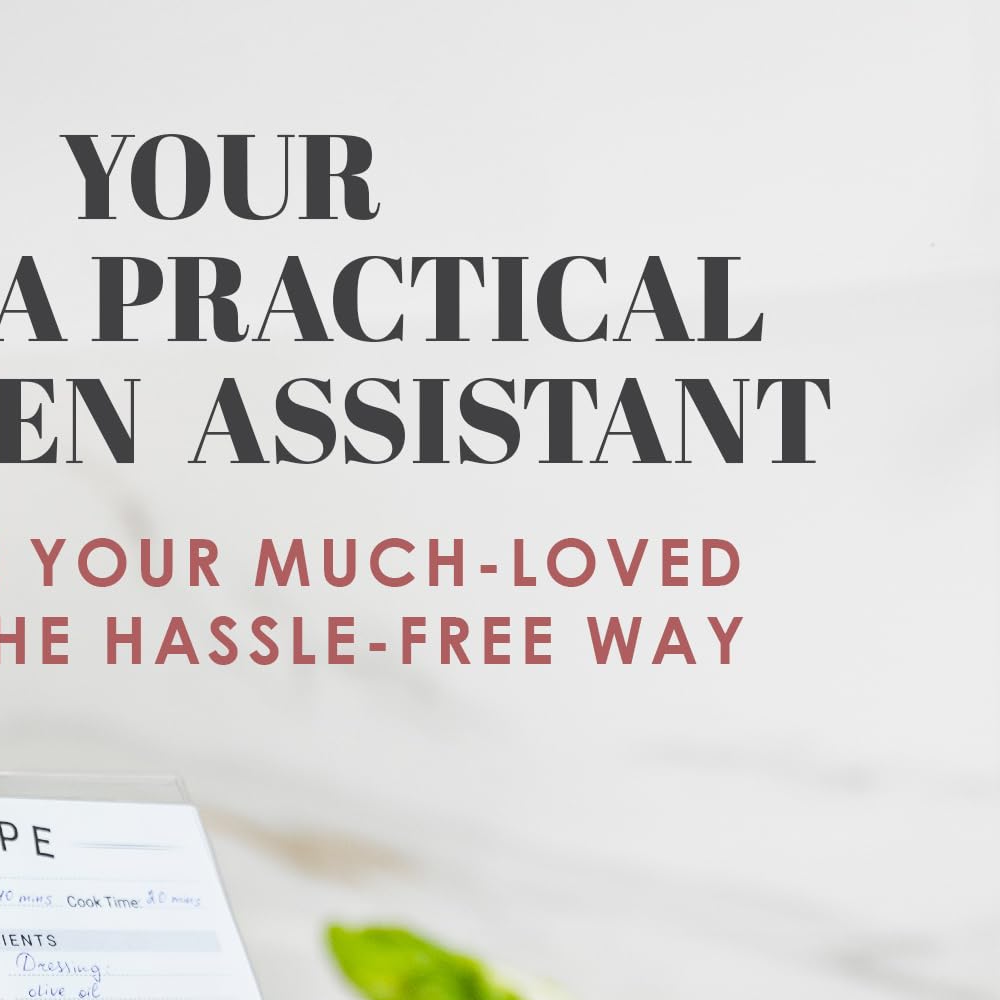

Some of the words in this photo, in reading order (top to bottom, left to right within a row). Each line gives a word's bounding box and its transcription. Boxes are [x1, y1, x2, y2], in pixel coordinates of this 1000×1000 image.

[67, 895, 101, 909] Cook
[28, 984, 65, 998] olive
[78, 982, 102, 999] oil
